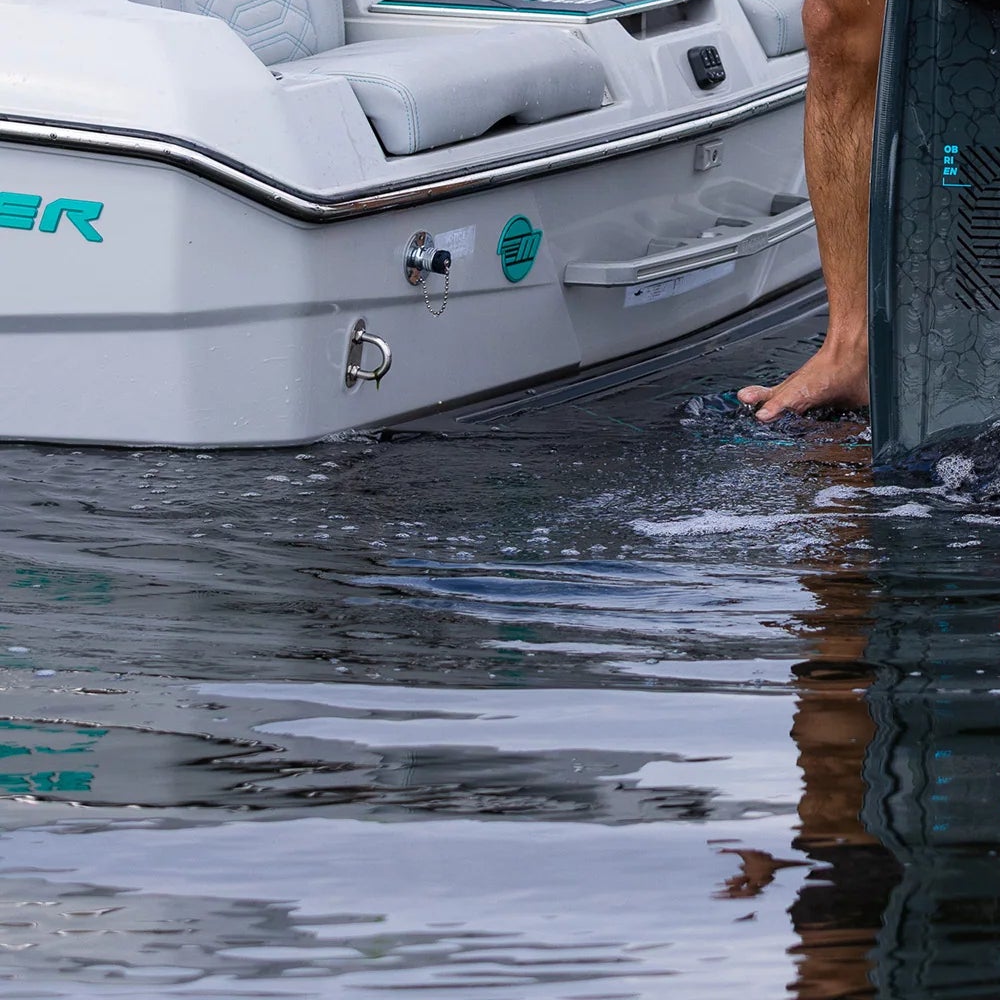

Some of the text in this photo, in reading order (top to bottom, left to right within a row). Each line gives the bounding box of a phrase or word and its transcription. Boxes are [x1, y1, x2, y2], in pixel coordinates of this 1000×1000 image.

[943, 144, 959, 154] OB
[943, 155, 954, 165] RI
[942, 166, 958, 176] EN
